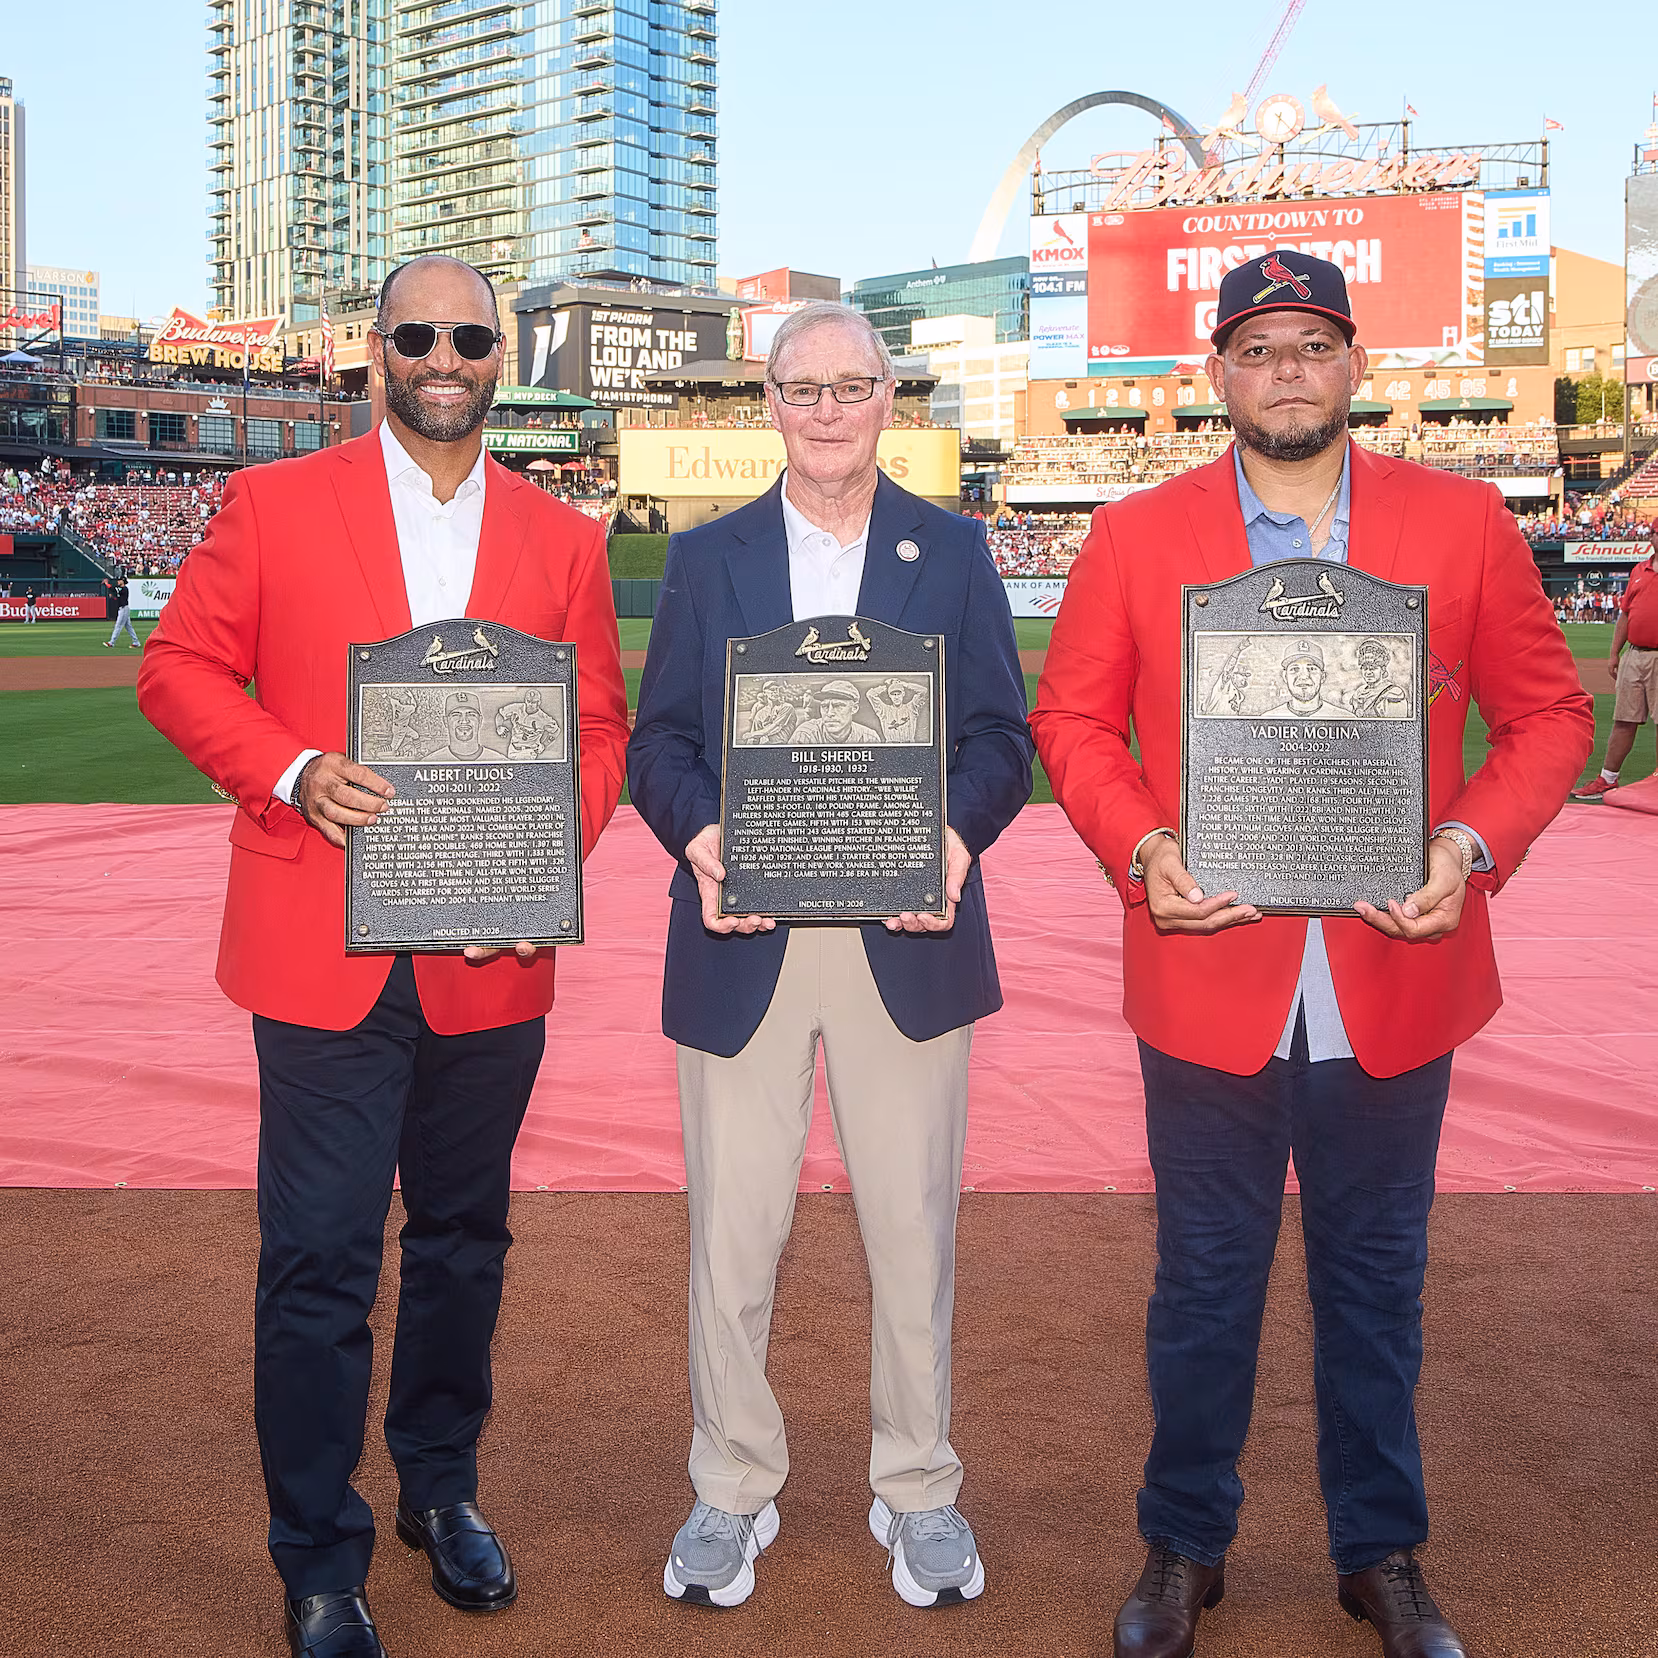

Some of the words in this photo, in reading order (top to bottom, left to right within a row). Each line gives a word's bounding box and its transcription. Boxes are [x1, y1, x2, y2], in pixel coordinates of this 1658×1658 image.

[1183, 210, 1328, 234] COUNTDOWN
[1332, 208, 1364, 226] TO
[1032, 248, 1084, 262] KMOX
[36, 270, 84, 283] LARSON
[906, 279, 932, 288] Anthem
[1032, 282, 1062, 293] 104.1
[1066, 281, 1085, 292] FM
[152, 316, 281, 346] Budweiser
[590, 325, 651, 348] FROM
[656, 329, 697, 351] THE
[1488, 326, 1544, 338] TODAY
[150, 344, 210, 366] BREW
[214, 350, 283, 373] HOUSE
[590, 346, 632, 368] LOU
[636, 350, 682, 370] AND
[514, 392, 533, 401] MVP
[534, 393, 557, 401] DECK
[590, 390, 672, 404] #IAM1STPHORM
[1106, 388, 1118, 408] 2
[1152, 387, 1165, 406] 9
[1177, 386, 1196, 406] 10
[1385, 380, 1411, 400] 42
[1424, 380, 1450, 399] 45
[482, 434, 505, 447] ETY
[506, 434, 572, 448] NATIONAL
[1571, 543, 1653, 555] Schnucks
[1272, 598, 1341, 622] Cardinals
[807, 644, 868, 664] Cardinals
[433, 653, 495, 673] Cardinals
[1250, 726, 1298, 739] YADIER
[1304, 726, 1360, 739] MOLINA
[1280, 742, 1330, 752] 2004-2022
[792, 752, 816, 762] BILL
[821, 751, 874, 762] SHERDEL
[414, 769, 461, 781] ALBERT
[466, 768, 514, 780] PUJOLS
[800, 765, 844, 773] 1918-1930,
[478, 783, 500, 792] 2022
